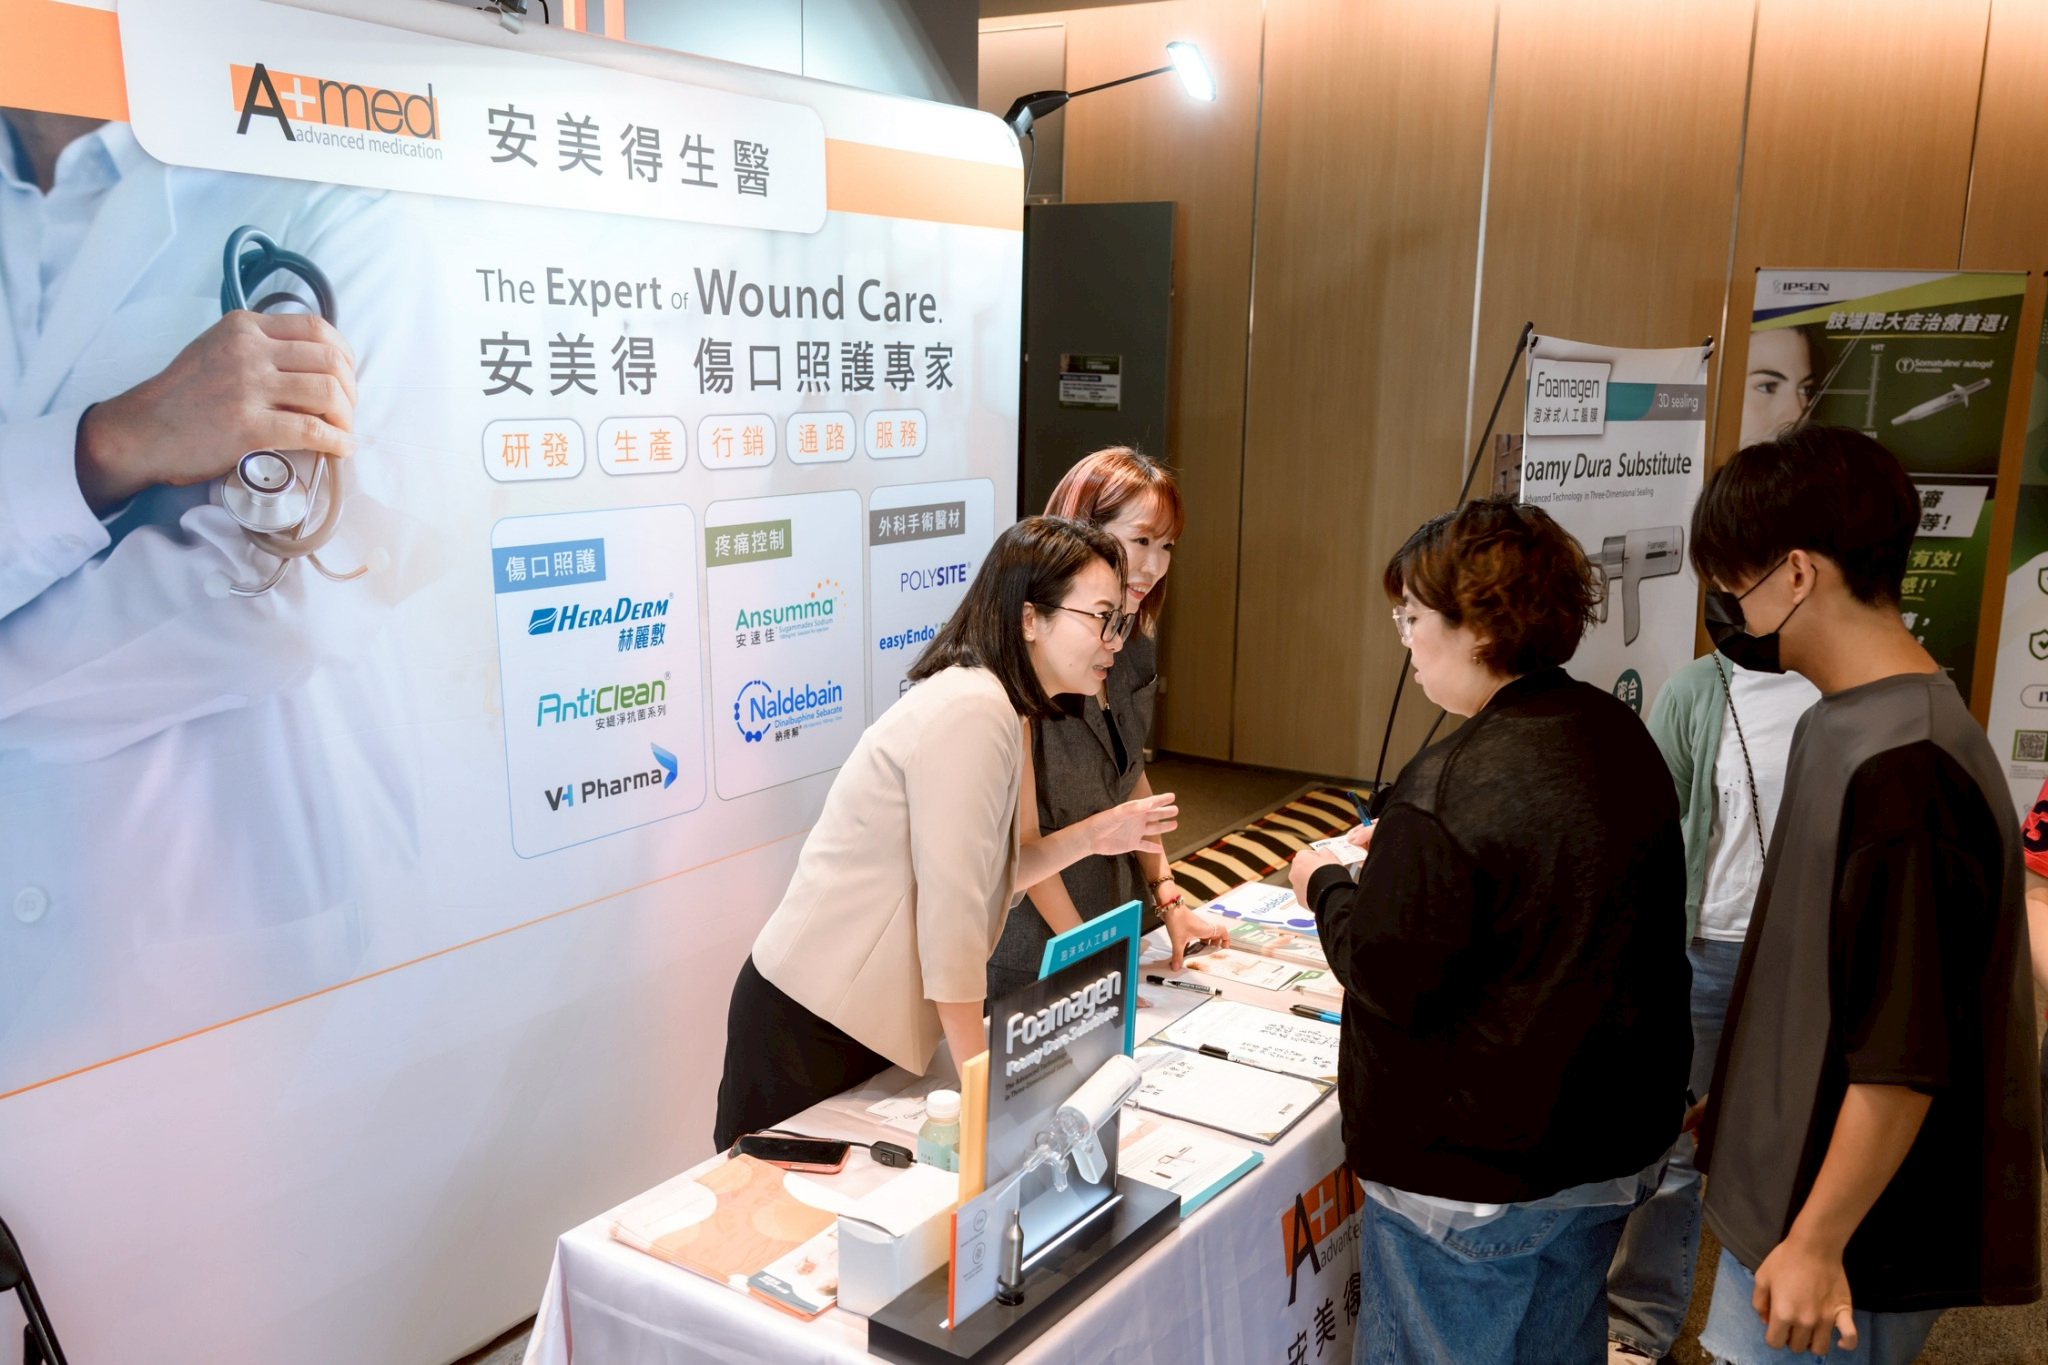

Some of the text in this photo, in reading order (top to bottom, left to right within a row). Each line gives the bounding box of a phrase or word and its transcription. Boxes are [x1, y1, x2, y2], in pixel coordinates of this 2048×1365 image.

[296, 127, 443, 161] advanced medication
[487, 103, 771, 198] 安美得生醫
[476, 269, 536, 304] The
[545, 267, 663, 316] Expert
[693, 267, 845, 321] Wound
[857, 278, 944, 324] Care.
[1783, 282, 1830, 291] IPSEN
[1825, 311, 2009, 333] 肢端肥大症治療首選!
[1871, 343, 1885, 351] HIT
[479, 331, 954, 397] 安美得 傷口照護專家
[1536, 371, 1600, 403] Foamagen
[1658, 393, 1698, 412] 3D sealing
[1532, 407, 1599, 424] 泡沫式人工腦膜
[501, 431, 570, 469] 研發
[613, 428, 674, 464] 生產
[711, 426, 765, 459] 行銷
[798, 421, 846, 455] 通路
[874, 419, 918, 449] 服務
[1525, 451, 1692, 487] oamy Dura Substitute
[1552, 491, 1583, 503] Technology
[1584, 491, 1590, 500] in
[1590, 488, 1637, 500] Three-Dimensional
[1637, 487, 1654, 497] Sealing
[1918, 489, 1944, 509] 審
[878, 509, 961, 537] 外科手術醫材
[714, 528, 785, 558] 疼痛控制
[505, 549, 597, 582] 傷口照護
[901, 563, 967, 593] POLYSITE
[735, 598, 834, 631] Ansumma
[618, 622, 666, 652] 赫麗敷
[736, 628, 775, 649] 安速佳
[879, 625, 935, 650] easyEndo
[750, 680, 843, 722] Naldebain
[815, 706, 843, 718] Sebacate
[581, 768, 662, 803] Pharma
[1006, 971, 1122, 1054] Foamagen
[1006, 1047, 1043, 1077] Foamy
[1043, 1033, 1070, 1056] Dura
